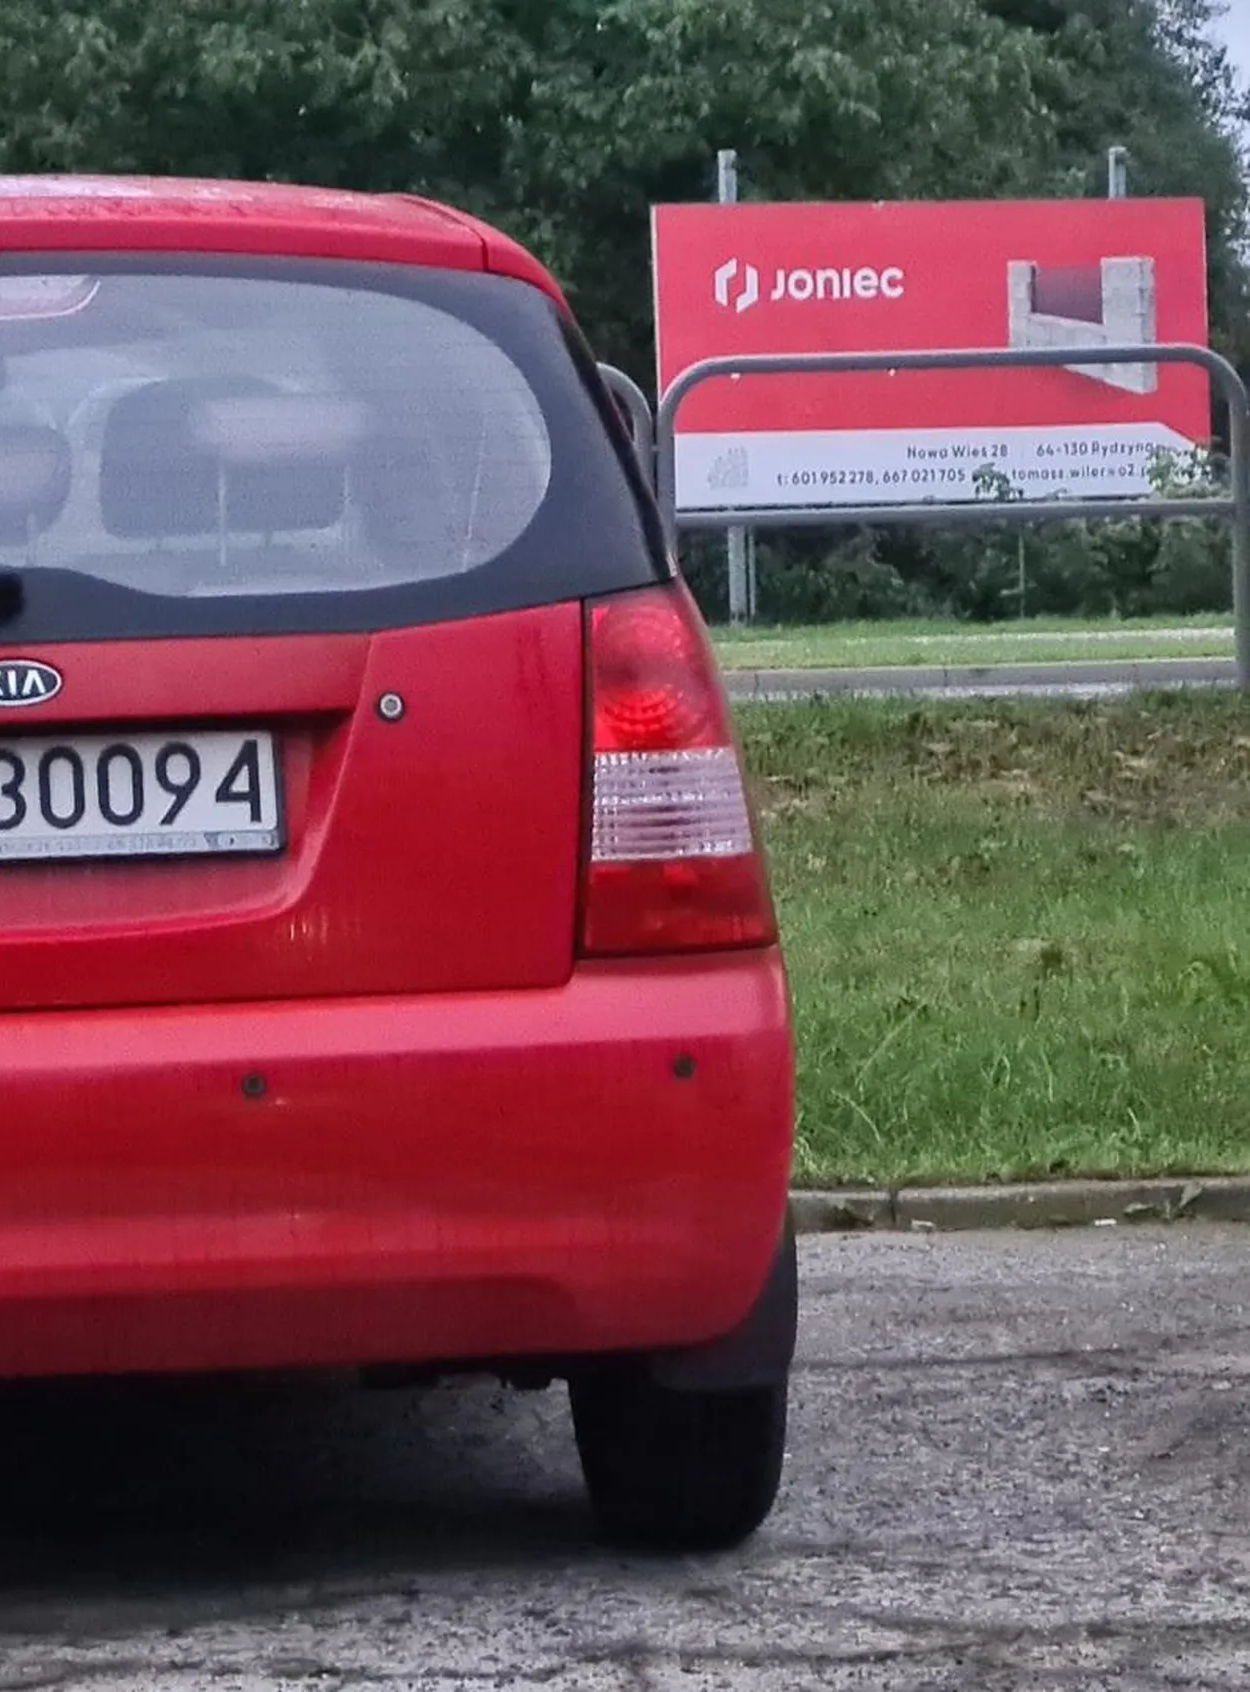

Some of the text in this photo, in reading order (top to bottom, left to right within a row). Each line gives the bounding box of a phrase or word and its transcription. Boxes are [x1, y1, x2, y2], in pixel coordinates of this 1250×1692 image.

[907, 445, 948, 460] Nowa
[991, 443, 1008, 458] 28
[1036, 441, 1089, 458] 64-130
